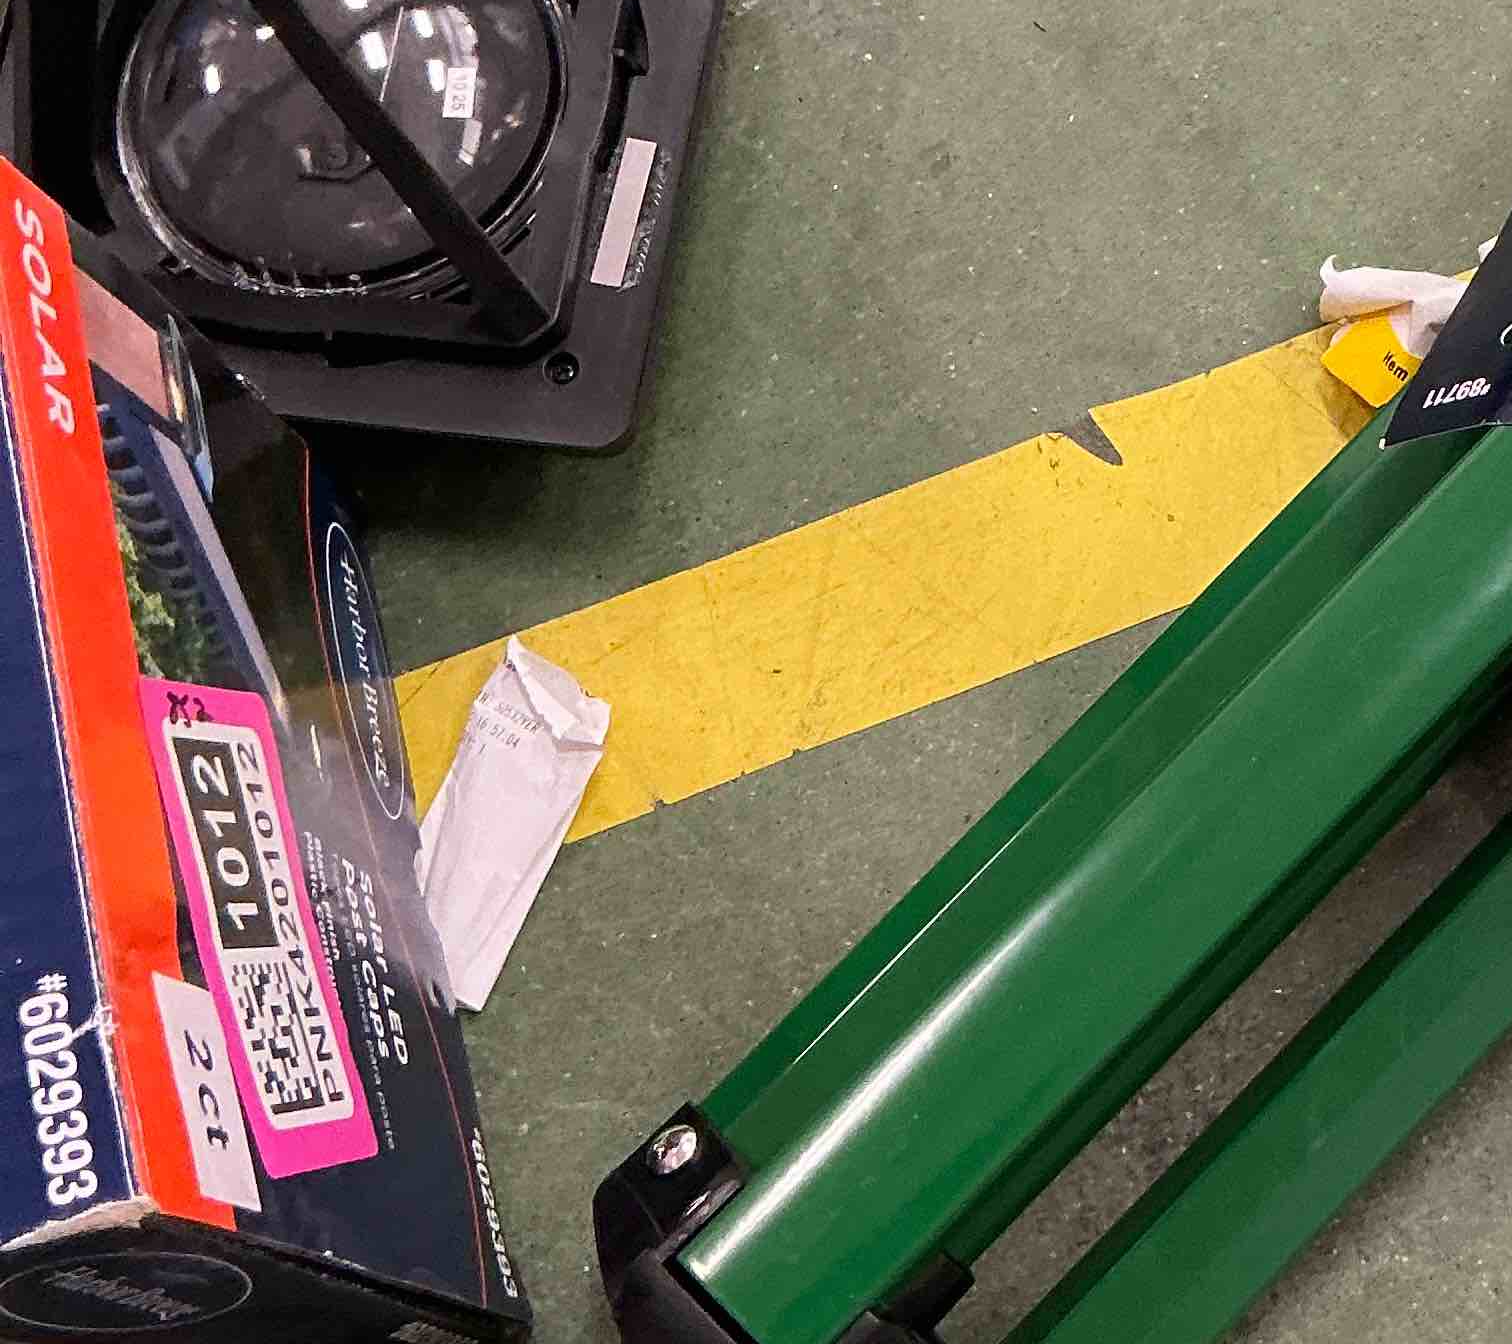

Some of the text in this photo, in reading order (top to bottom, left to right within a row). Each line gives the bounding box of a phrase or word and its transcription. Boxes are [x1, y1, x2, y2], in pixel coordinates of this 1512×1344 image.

[15, 197, 77, 436] SOLAR
[1422, 376, 1492, 409] #89711
[339, 549, 391, 789] Harbor Breeze
[190, 754, 260, 932] 1012
[236, 741, 346, 1103] PNK4201012
[340, 856, 369, 949] Post
[361, 959, 390, 1058] Caps
[359, 870, 409, 1066] Solar LED
[18, 972, 99, 1207] #6029393
